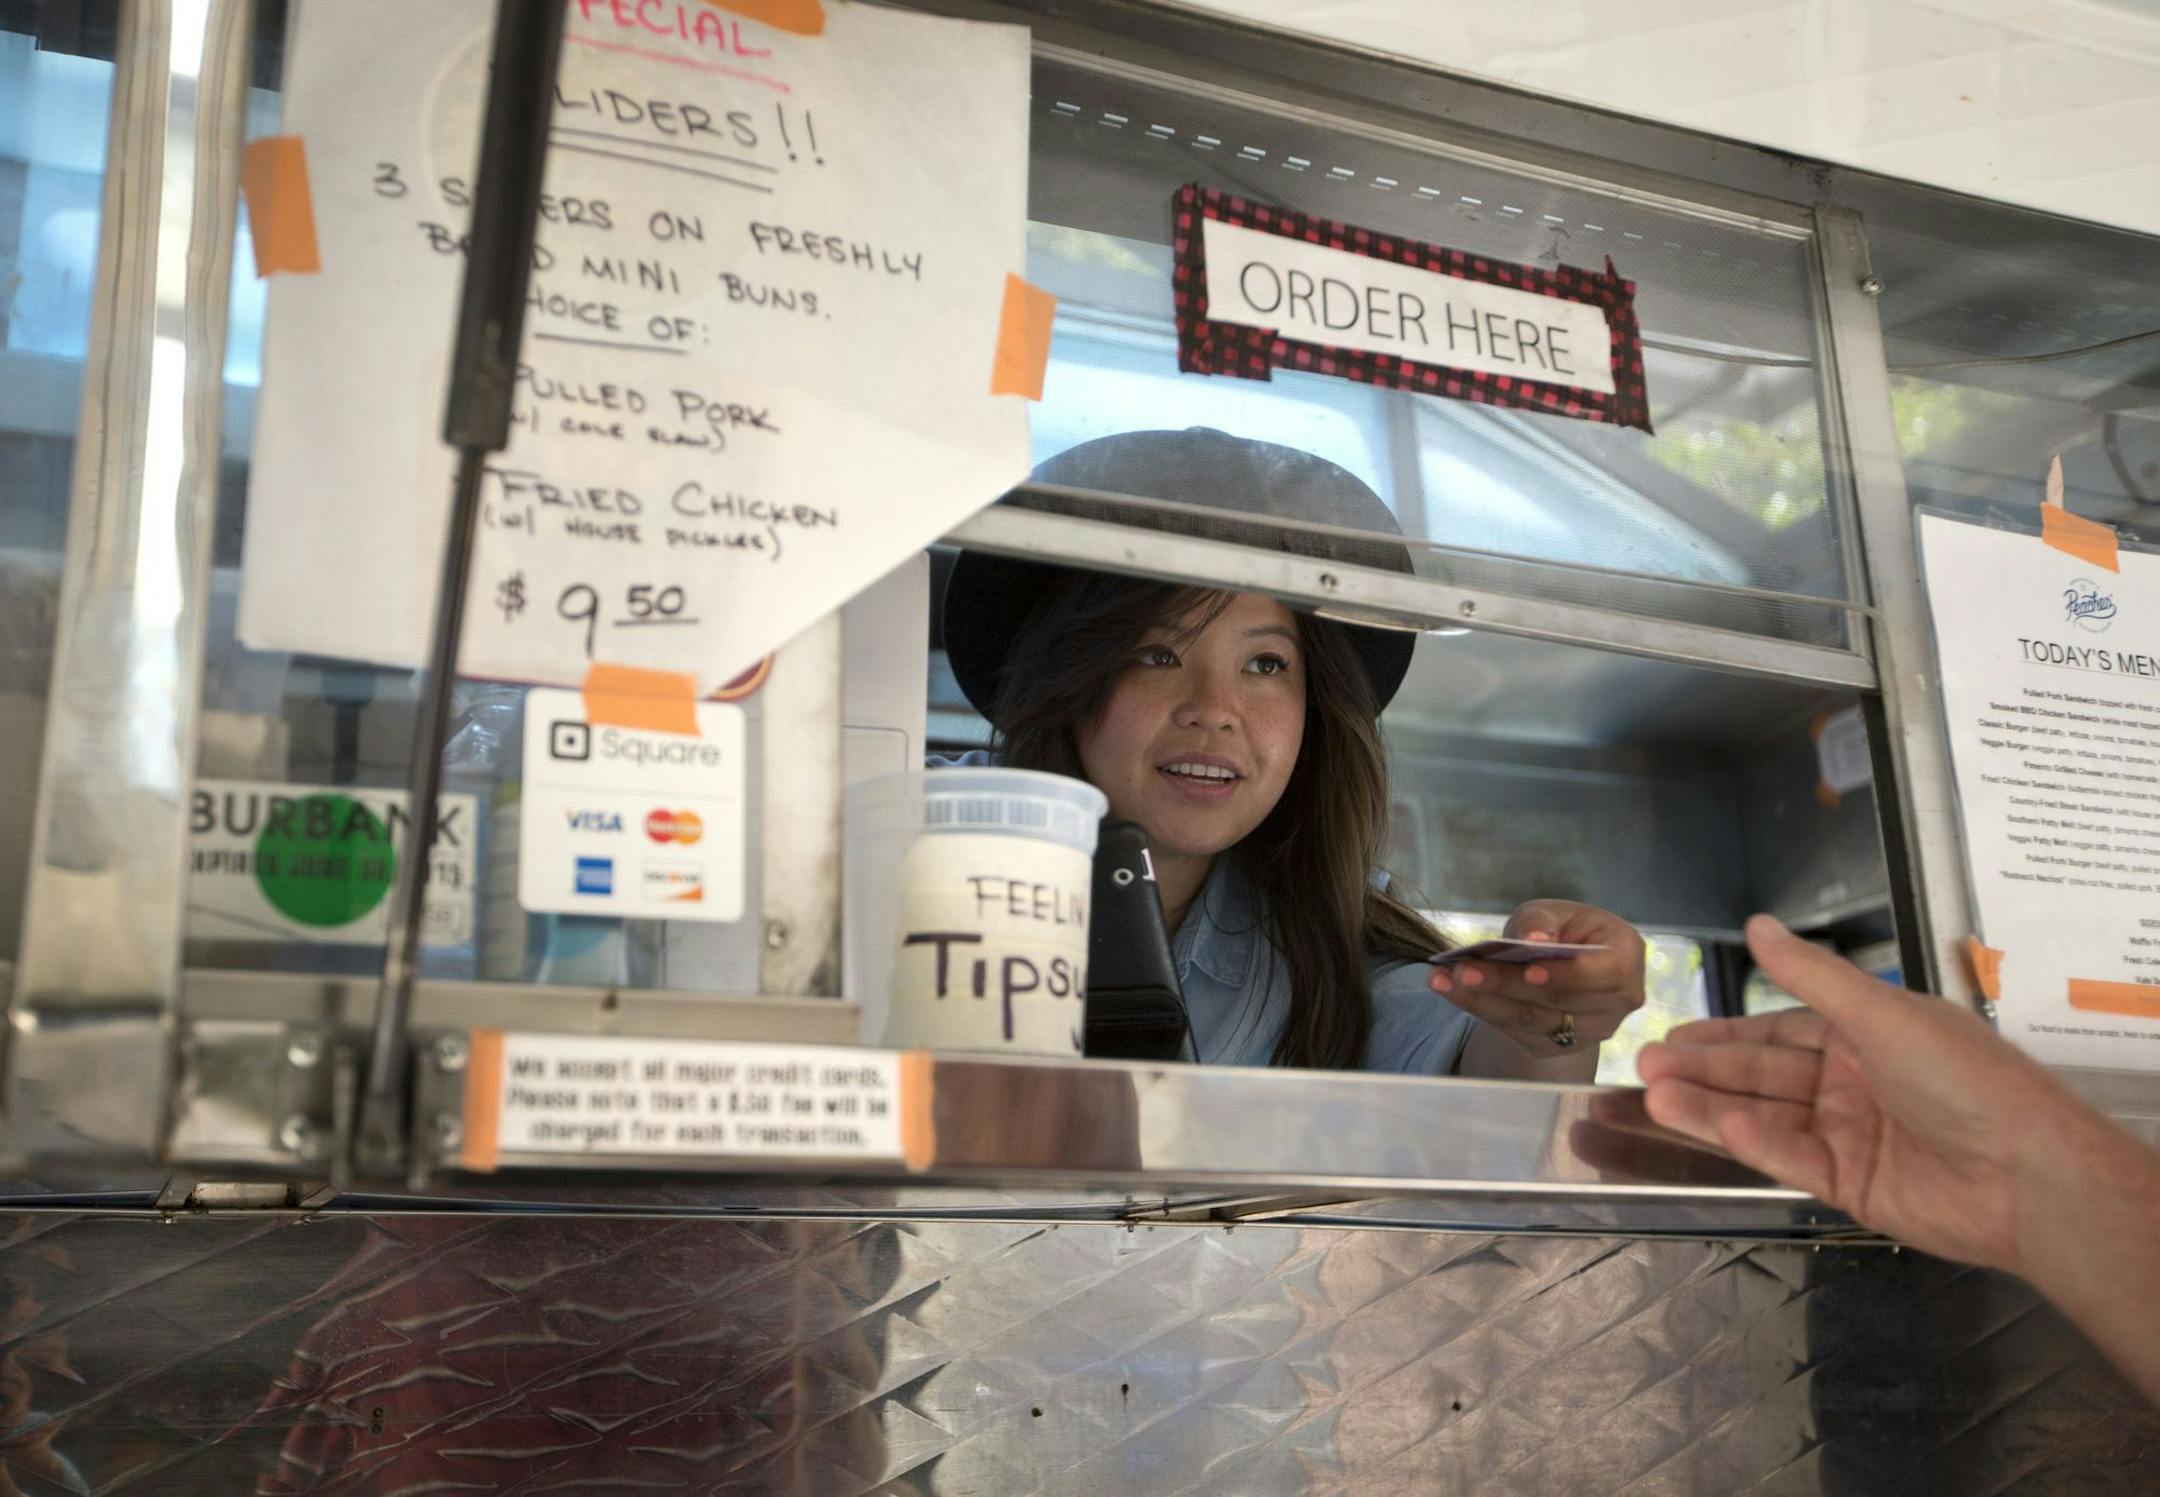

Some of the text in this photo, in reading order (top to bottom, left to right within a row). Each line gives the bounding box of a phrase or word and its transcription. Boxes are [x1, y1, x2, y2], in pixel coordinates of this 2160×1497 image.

[374, 163, 408, 198] 3
[649, 211, 704, 241] ON
[750, 221, 921, 281] FRESHLY
[581, 255, 680, 293] MINI
[1239, 260, 1577, 376] ORDER HERE
[484, 467, 838, 527] FRIED CHICKEN
[2017, 638, 2112, 671] TODAY'S
[601, 728, 721, 767] Square
[566, 807, 624, 831] VISA
